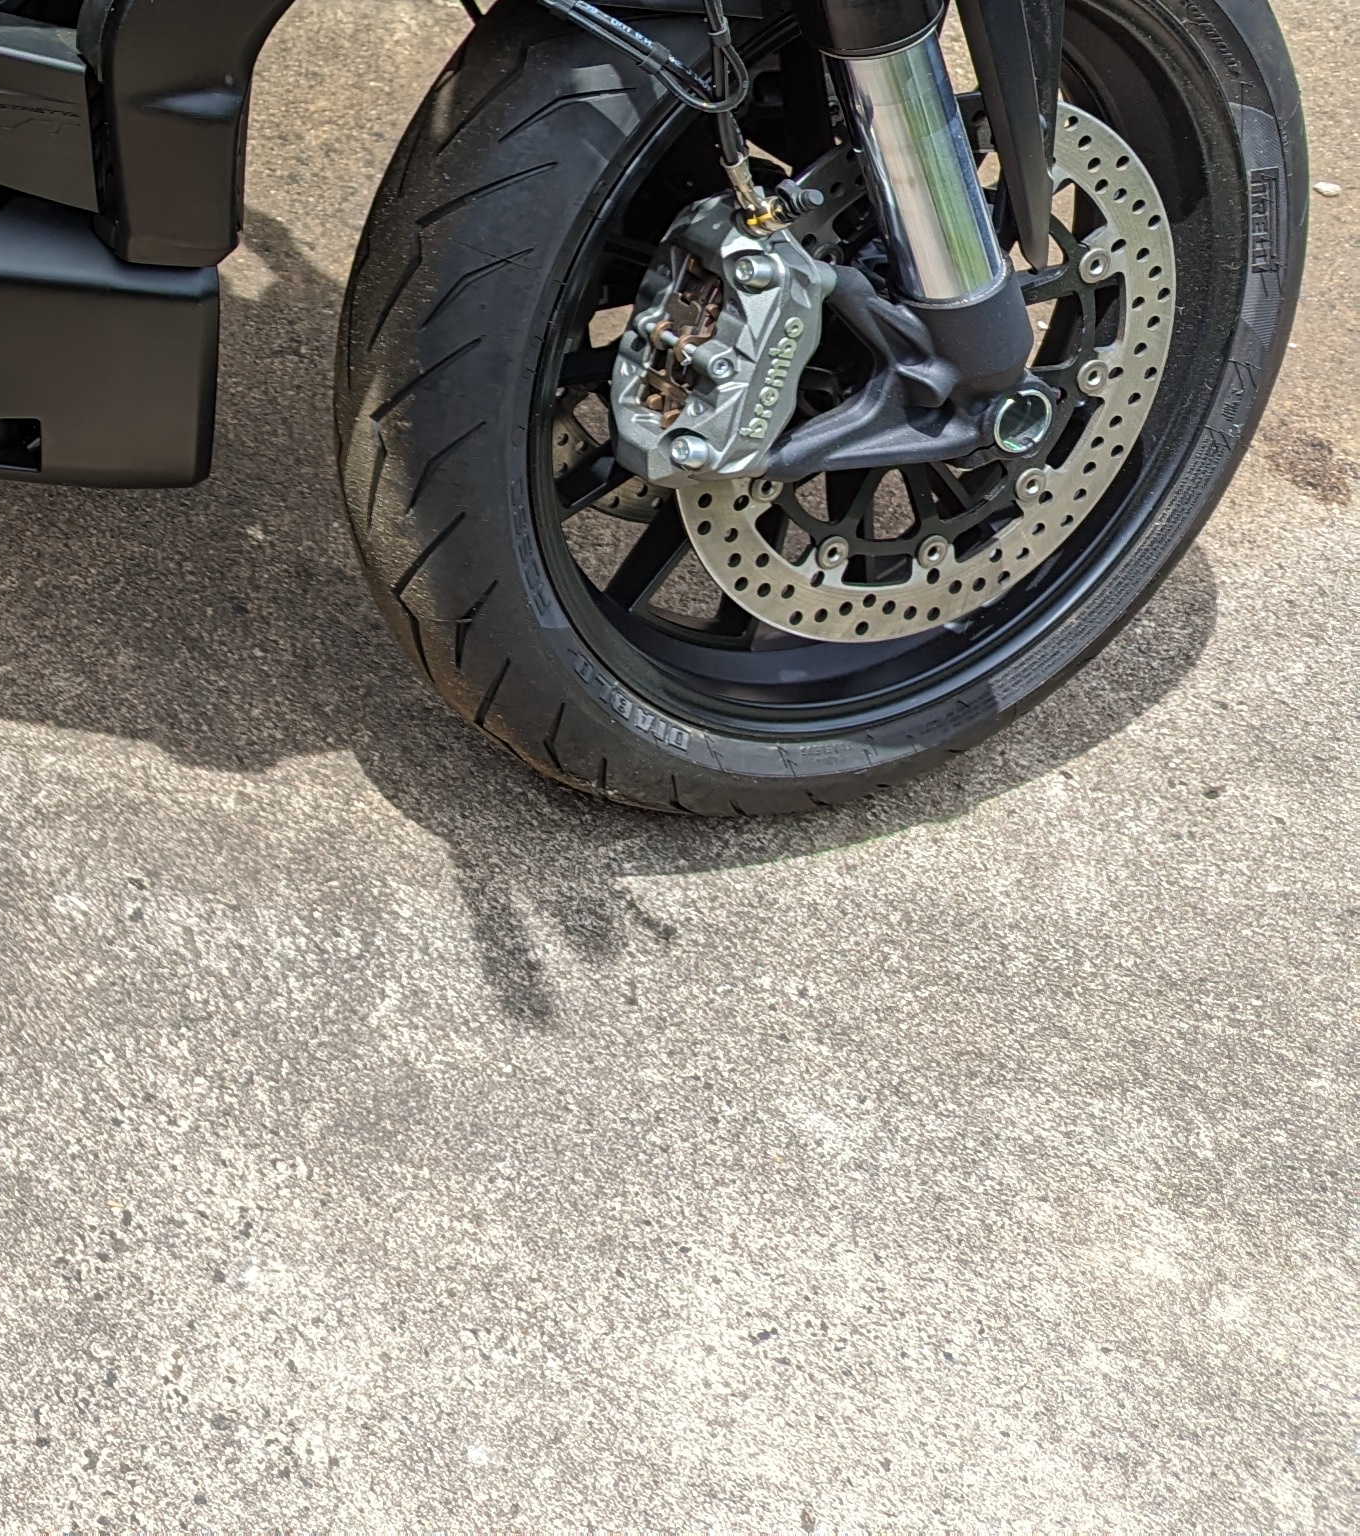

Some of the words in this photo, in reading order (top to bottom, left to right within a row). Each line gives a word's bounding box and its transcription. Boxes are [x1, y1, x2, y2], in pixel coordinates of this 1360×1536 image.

[1249, 166, 1280, 274] PIRELLI
[739, 316, 804, 439] brembo
[572, 653, 691, 753] DIABLO
